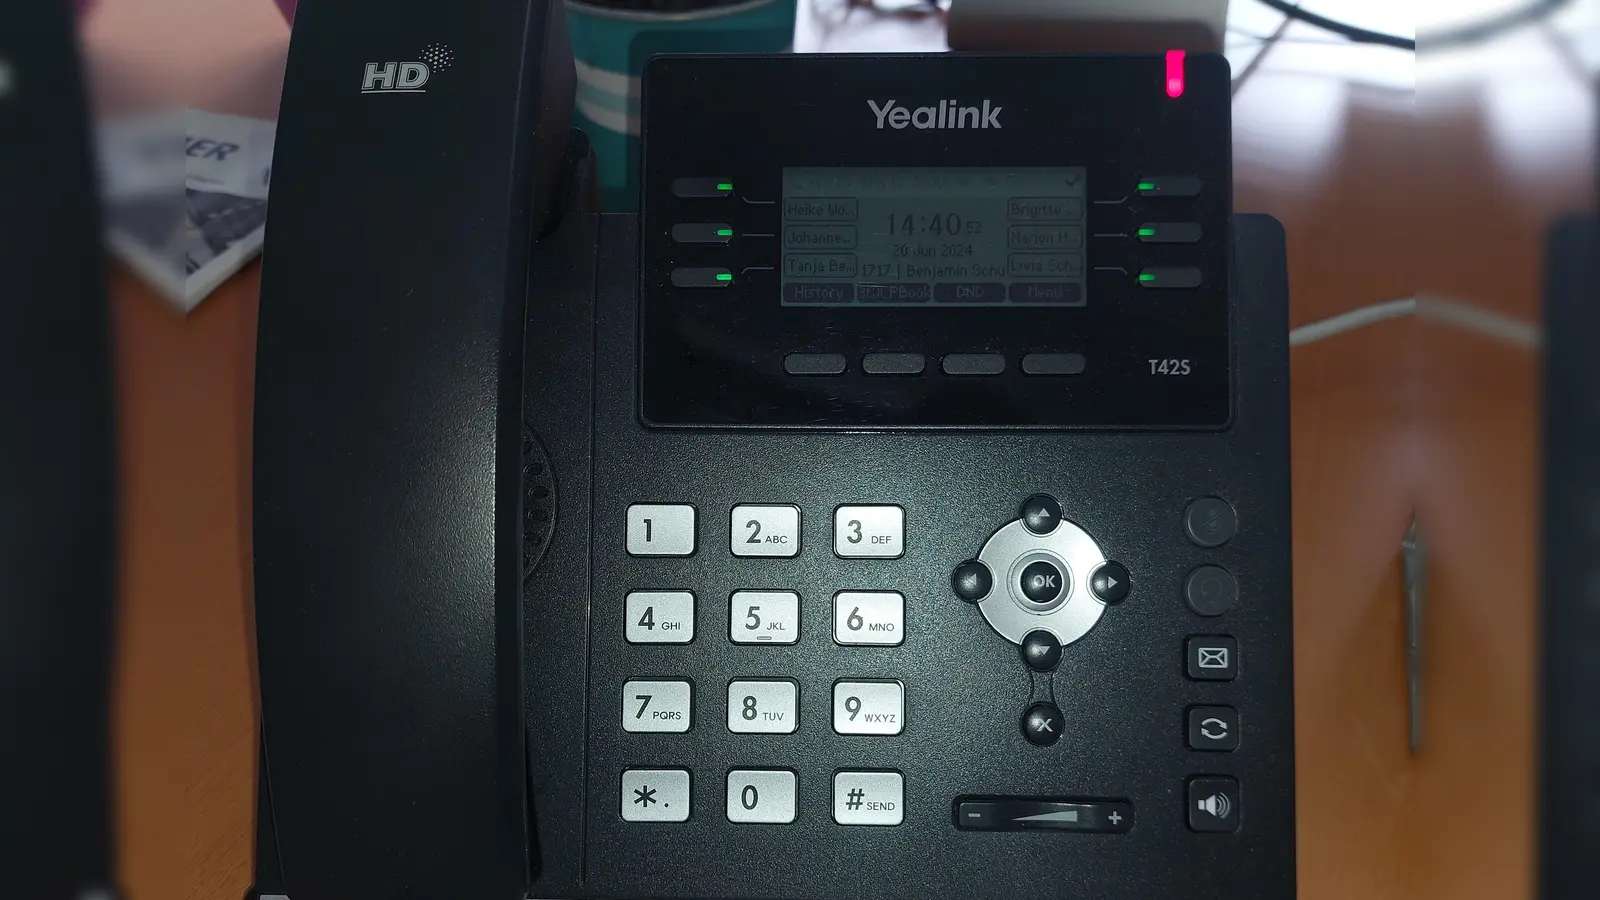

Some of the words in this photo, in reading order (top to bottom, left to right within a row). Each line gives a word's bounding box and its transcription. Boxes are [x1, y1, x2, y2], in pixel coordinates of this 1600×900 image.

[361, 61, 430, 90] HD
[866, 99, 1003, 130] Yealink
[185, 136, 240, 161] ER
[788, 202, 824, 216] Heike
[1010, 202, 1061, 218] Brigitte
[887, 212, 962, 236] 14:40
[966, 221, 982, 234] 52
[1010, 231, 1053, 244] Marion
[892, 244, 907, 257] 20
[911, 244, 936, 257] Jun
[941, 244, 973, 257] 2024
[788, 258, 824, 274] Tanja
[861, 264, 892, 278] 1717
[906, 263, 968, 279] Benjamin
[794, 285, 845, 301] History
[956, 285, 984, 299] DND
[1148, 359, 1191, 375] T42S
[642, 518, 653, 542] 1
[745, 519, 761, 544] 2
[765, 535, 788, 544] ABC
[847, 519, 863, 544] 3
[871, 535, 892, 544] DEF
[1034, 574, 1056, 589] OK
[638, 606, 655, 630] 4
[661, 621, 681, 631] GHI
[745, 606, 760, 630] 5
[766, 622, 785, 631] JKL
[847, 606, 864, 631] 6
[869, 623, 895, 632] MNO
[635, 695, 652, 719] 7
[652, 711, 682, 721] PQRS
[742, 695, 757, 720] 8
[762, 712, 784, 722] TUV
[844, 696, 862, 722] 9
[864, 713, 896, 723] WXYZ
[741, 784, 758, 810] 0
[845, 788, 864, 811] #
[866, 802, 895, 812] SEND
